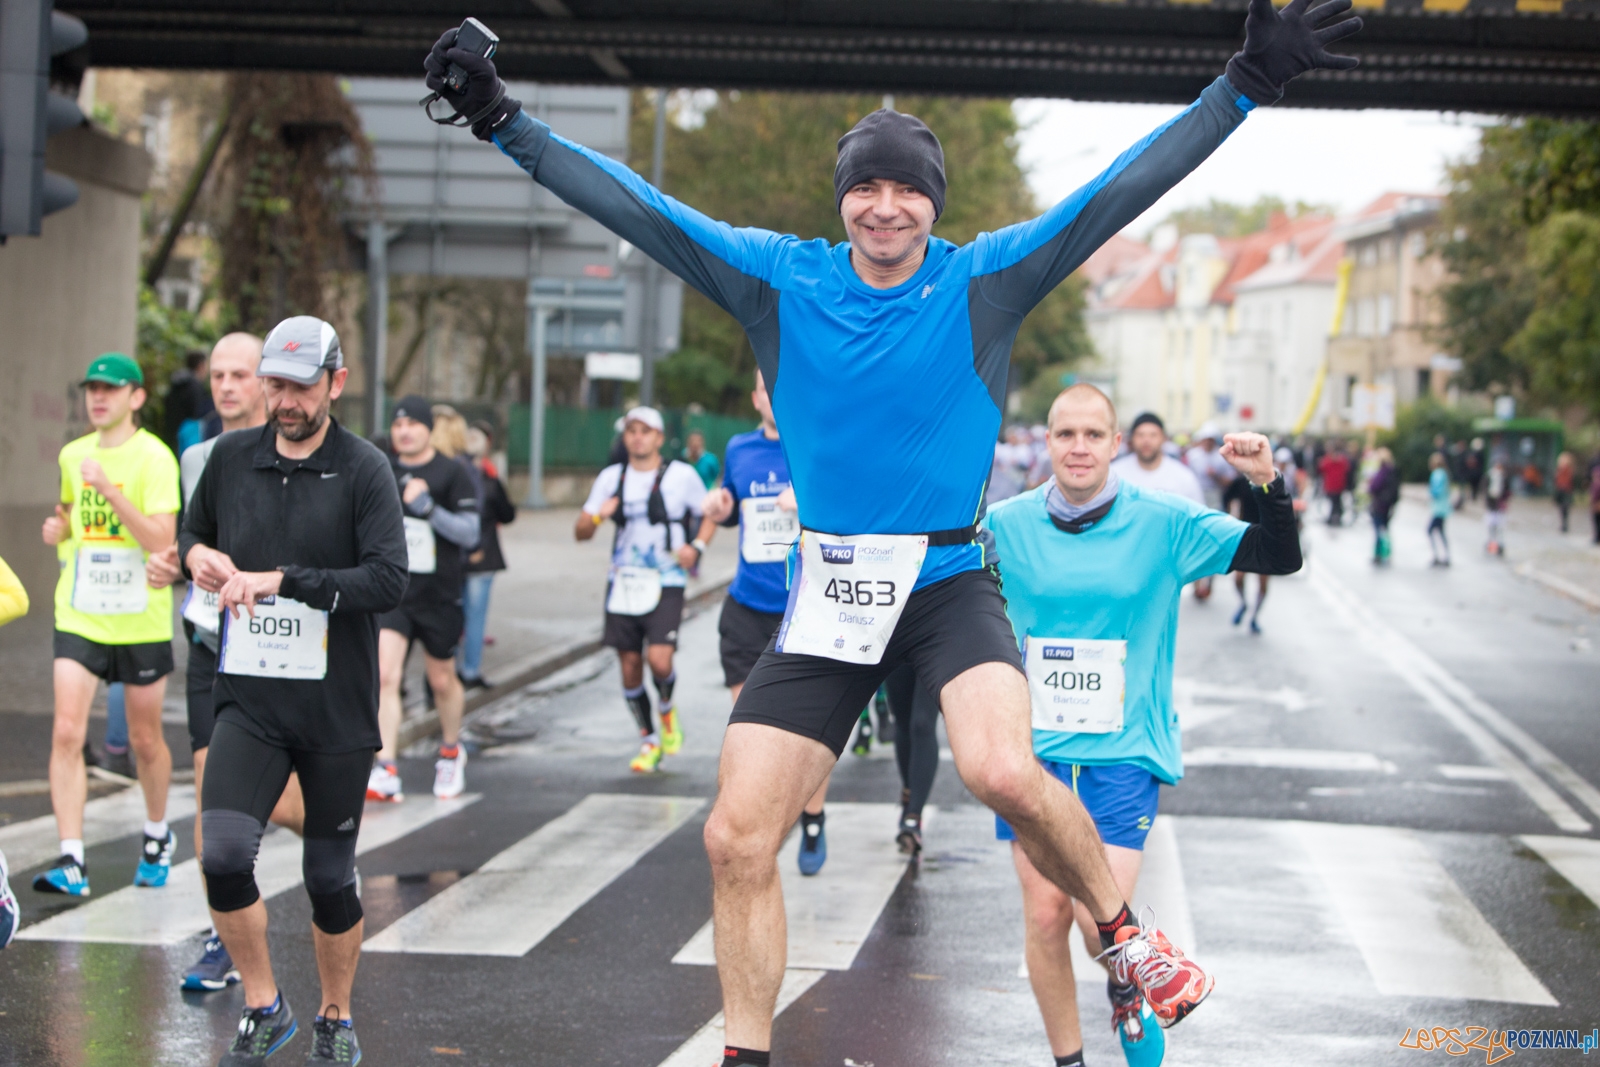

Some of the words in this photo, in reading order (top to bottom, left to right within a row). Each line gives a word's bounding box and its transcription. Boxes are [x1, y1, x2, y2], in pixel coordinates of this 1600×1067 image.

[80, 490, 112, 506] RU
[757, 518, 794, 532] 4163
[89, 570, 132, 584] 5832
[824, 578, 896, 606] 4363
[838, 611, 875, 626] Dariusz
[249, 616, 300, 637] 6091
[257, 641, 290, 650] Łukasz
[1045, 648, 1073, 658] 17.PKO
[1044, 671, 1101, 691] 4018
[1053, 695, 1090, 705] Bartosz
